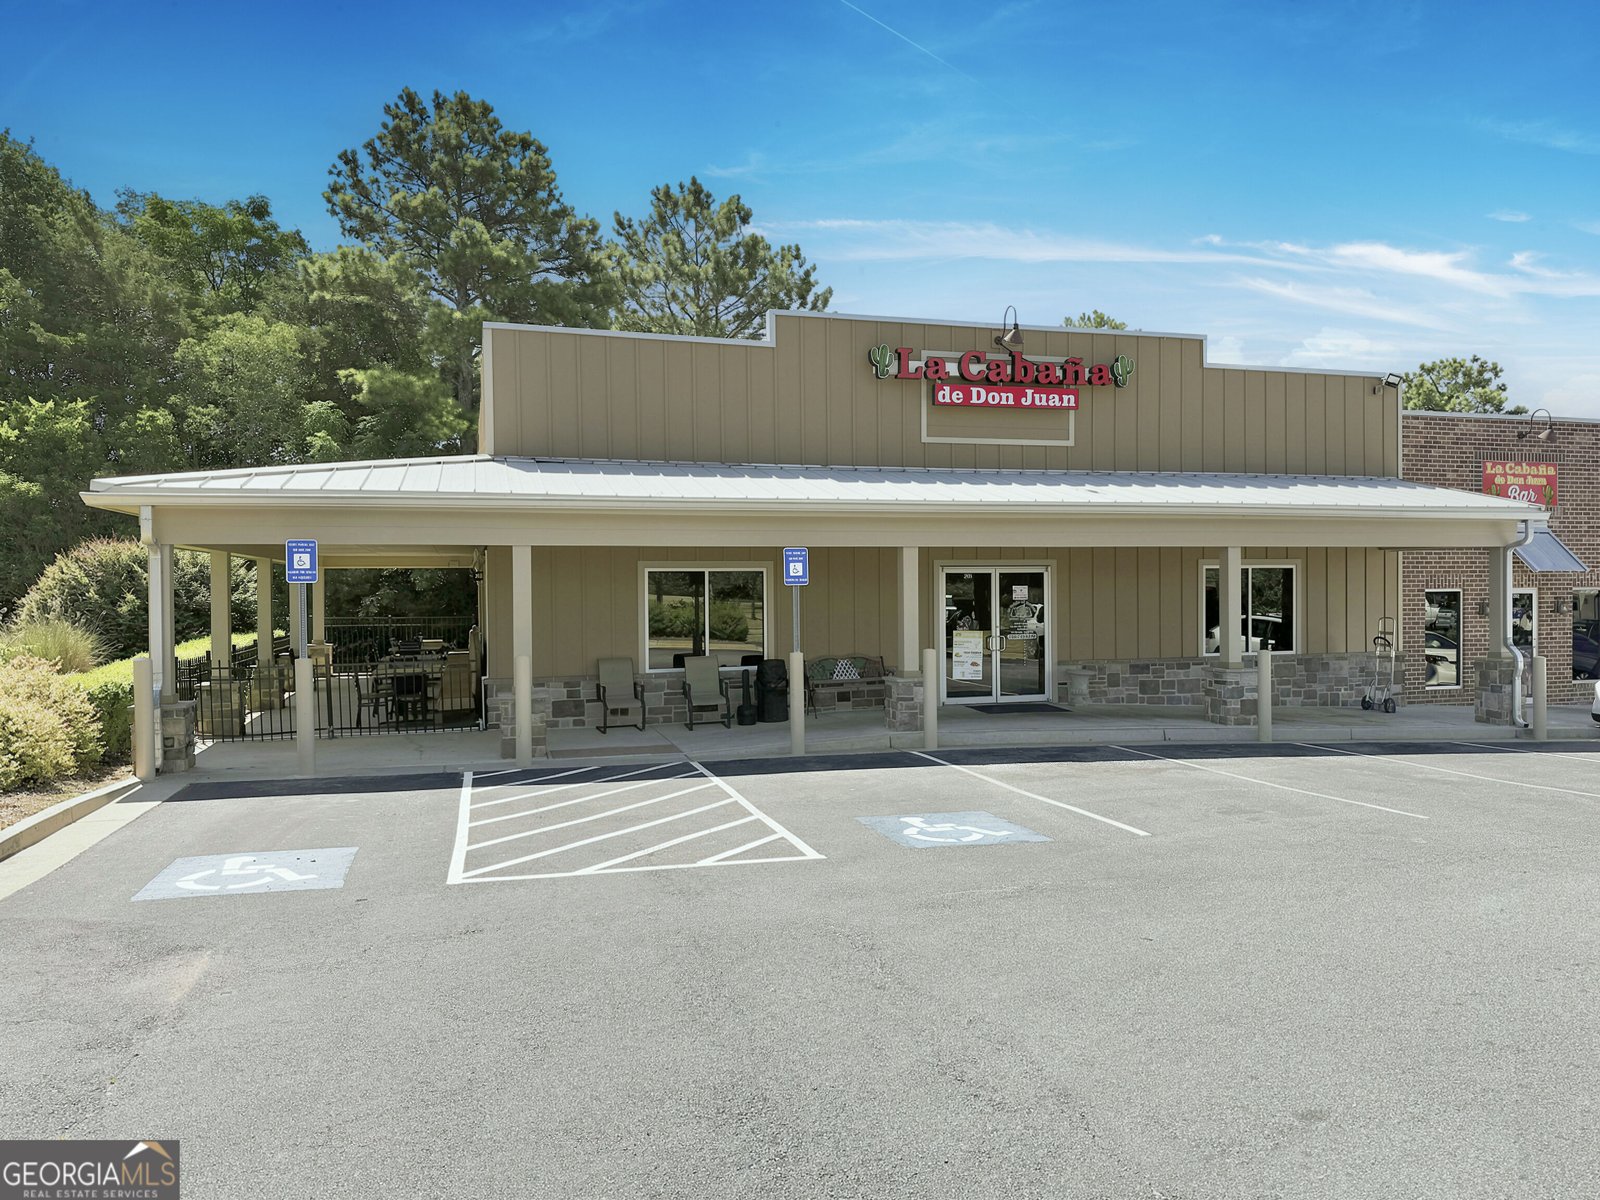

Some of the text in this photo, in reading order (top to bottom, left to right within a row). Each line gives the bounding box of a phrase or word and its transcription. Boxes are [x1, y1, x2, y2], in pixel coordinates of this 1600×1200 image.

[895, 347, 1113, 385] La Cabaña
[937, 386, 1076, 407] de Don Juan
[1485, 462, 1556, 476] La Cabaña
[1494, 475, 1547, 486] de Don Juan
[1508, 485, 1538, 502] Bar
